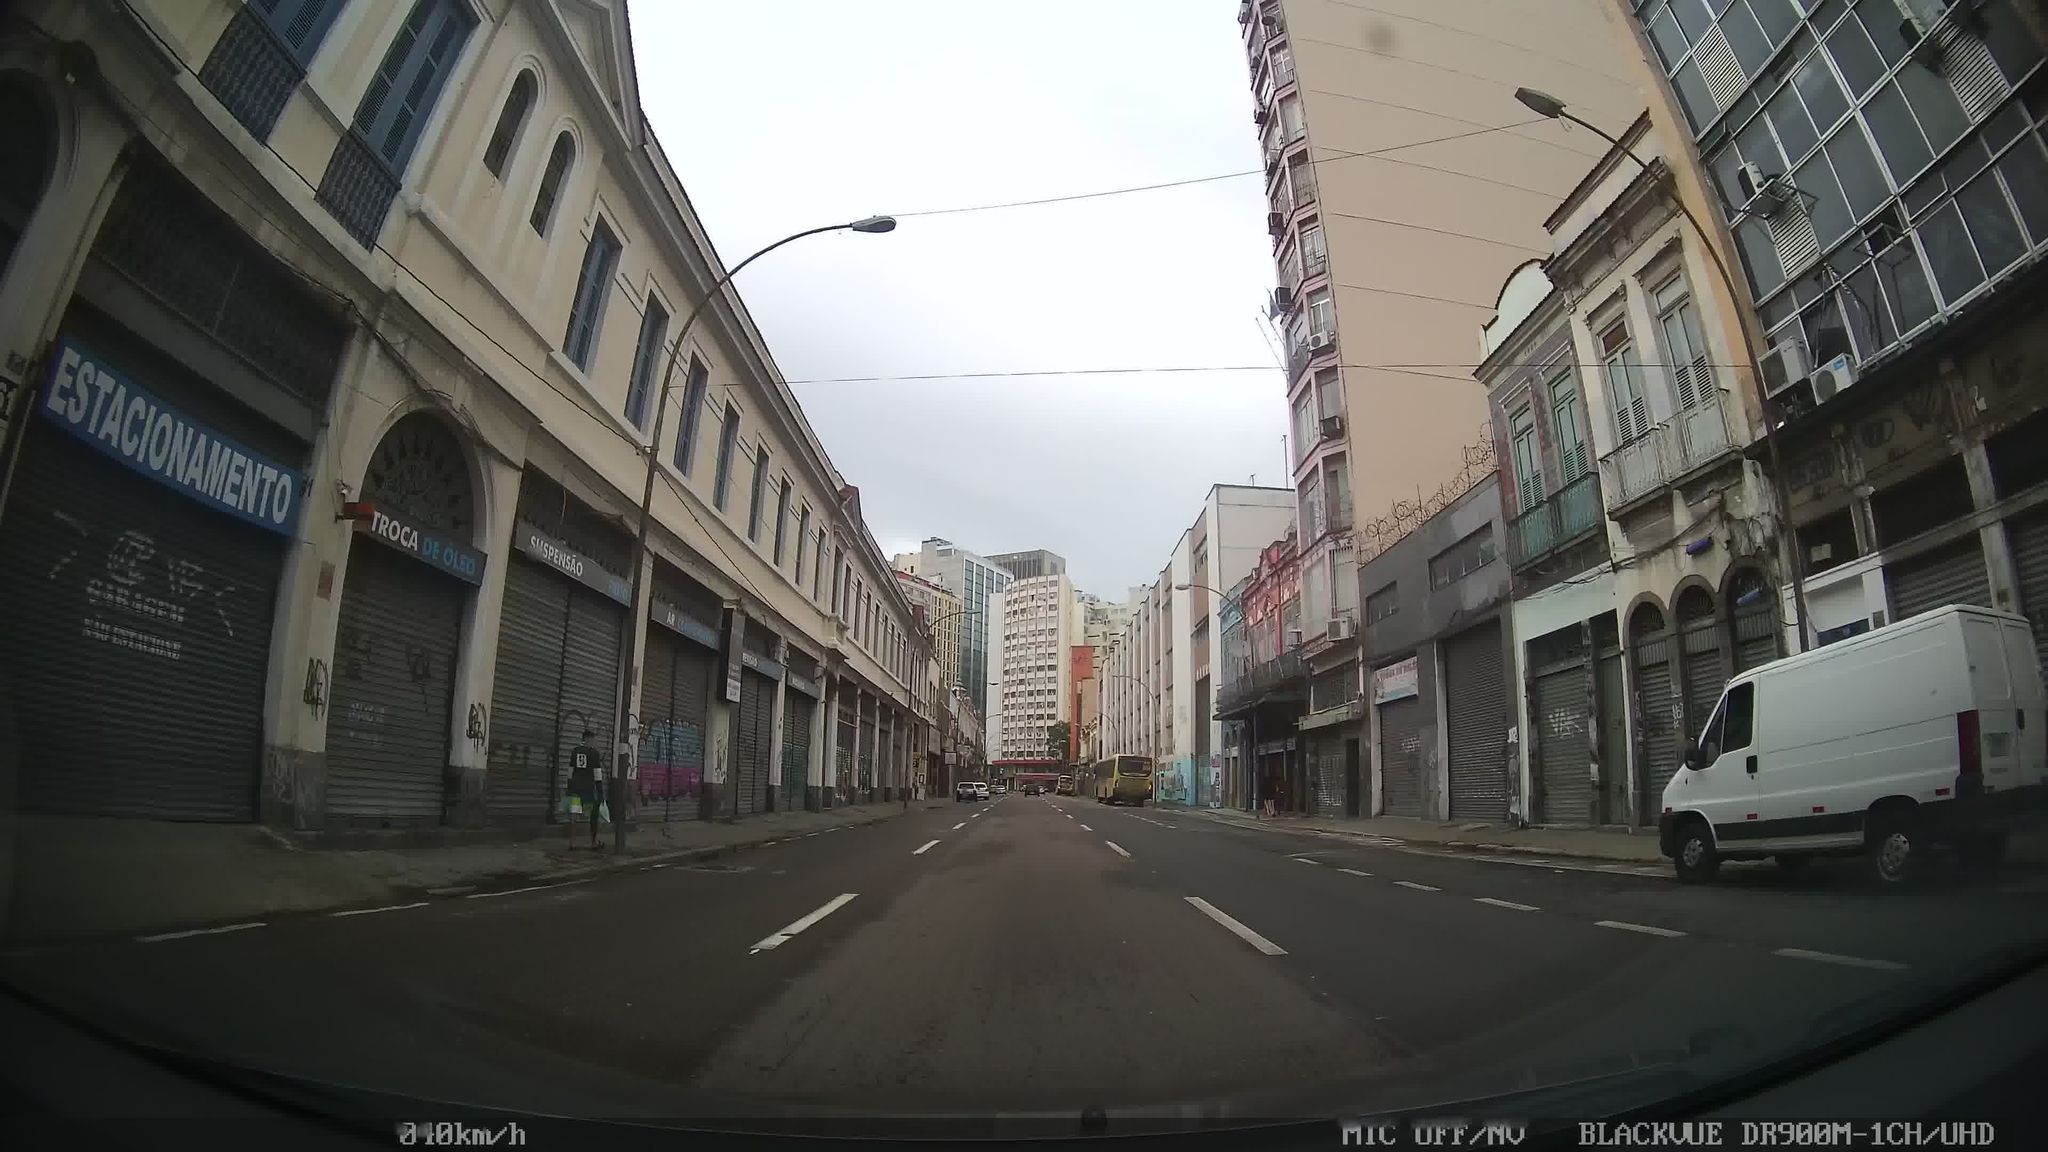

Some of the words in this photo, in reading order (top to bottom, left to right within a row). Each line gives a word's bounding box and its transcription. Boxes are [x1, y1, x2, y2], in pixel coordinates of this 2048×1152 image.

[46, 346, 293, 525] ESTACIONAMENTO
[371, 510, 419, 551] TROCA
[422, 536, 441, 560] DE
[530, 535, 583, 577] SUSPENSÃO
